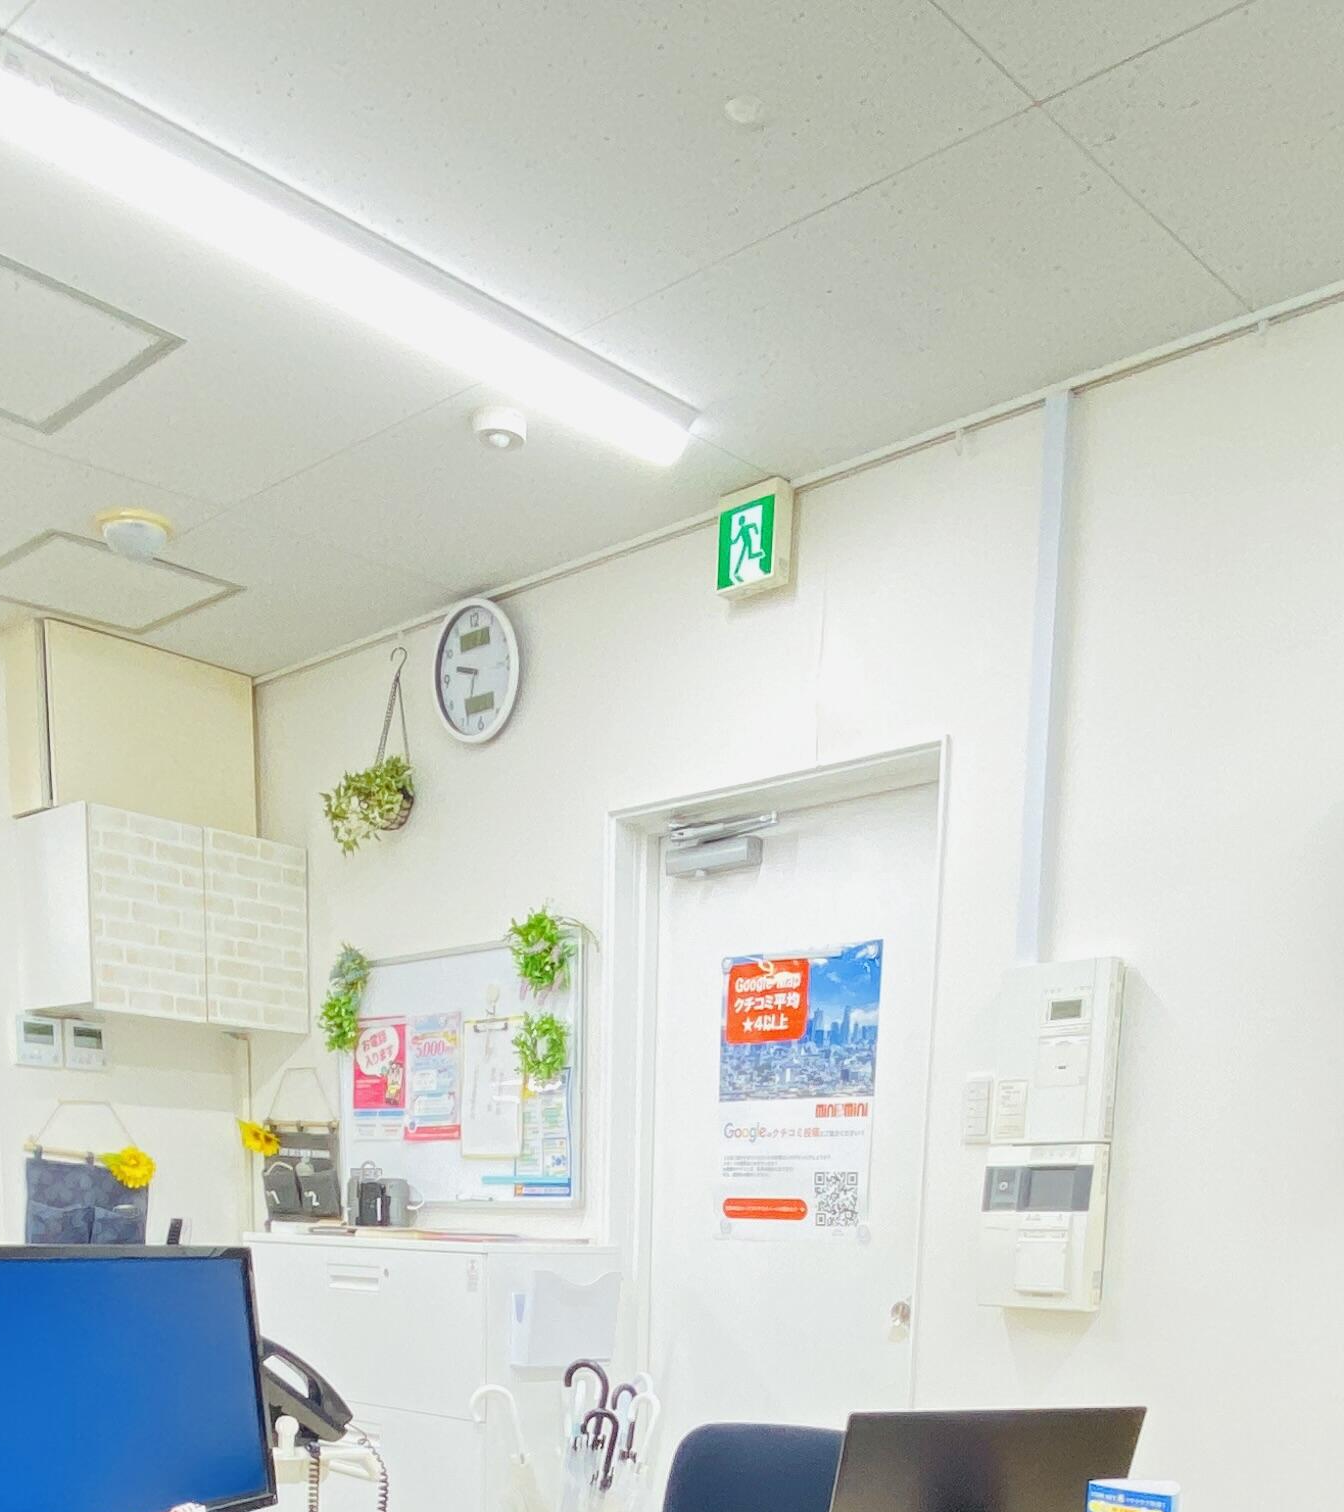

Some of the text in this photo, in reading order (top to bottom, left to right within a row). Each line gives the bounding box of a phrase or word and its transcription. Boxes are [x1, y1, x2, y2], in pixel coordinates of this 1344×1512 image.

[734, 991, 801, 1014] クチコミ平均
